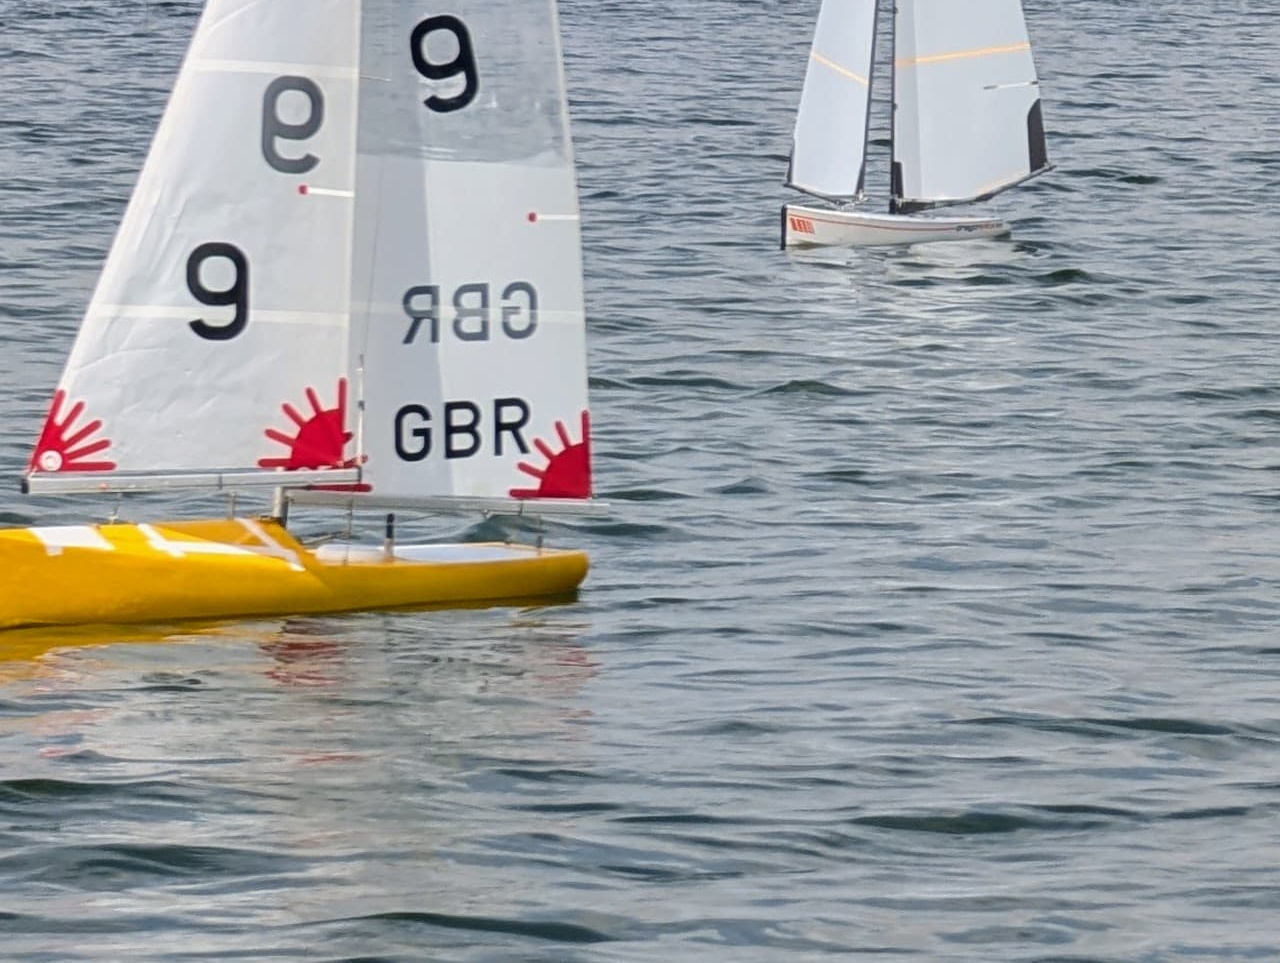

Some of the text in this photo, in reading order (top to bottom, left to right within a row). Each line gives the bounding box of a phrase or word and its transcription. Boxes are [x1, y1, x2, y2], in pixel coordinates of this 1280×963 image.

[410, 15, 479, 113] 9
[186, 242, 249, 340] 9
[394, 397, 531, 461] GBR
